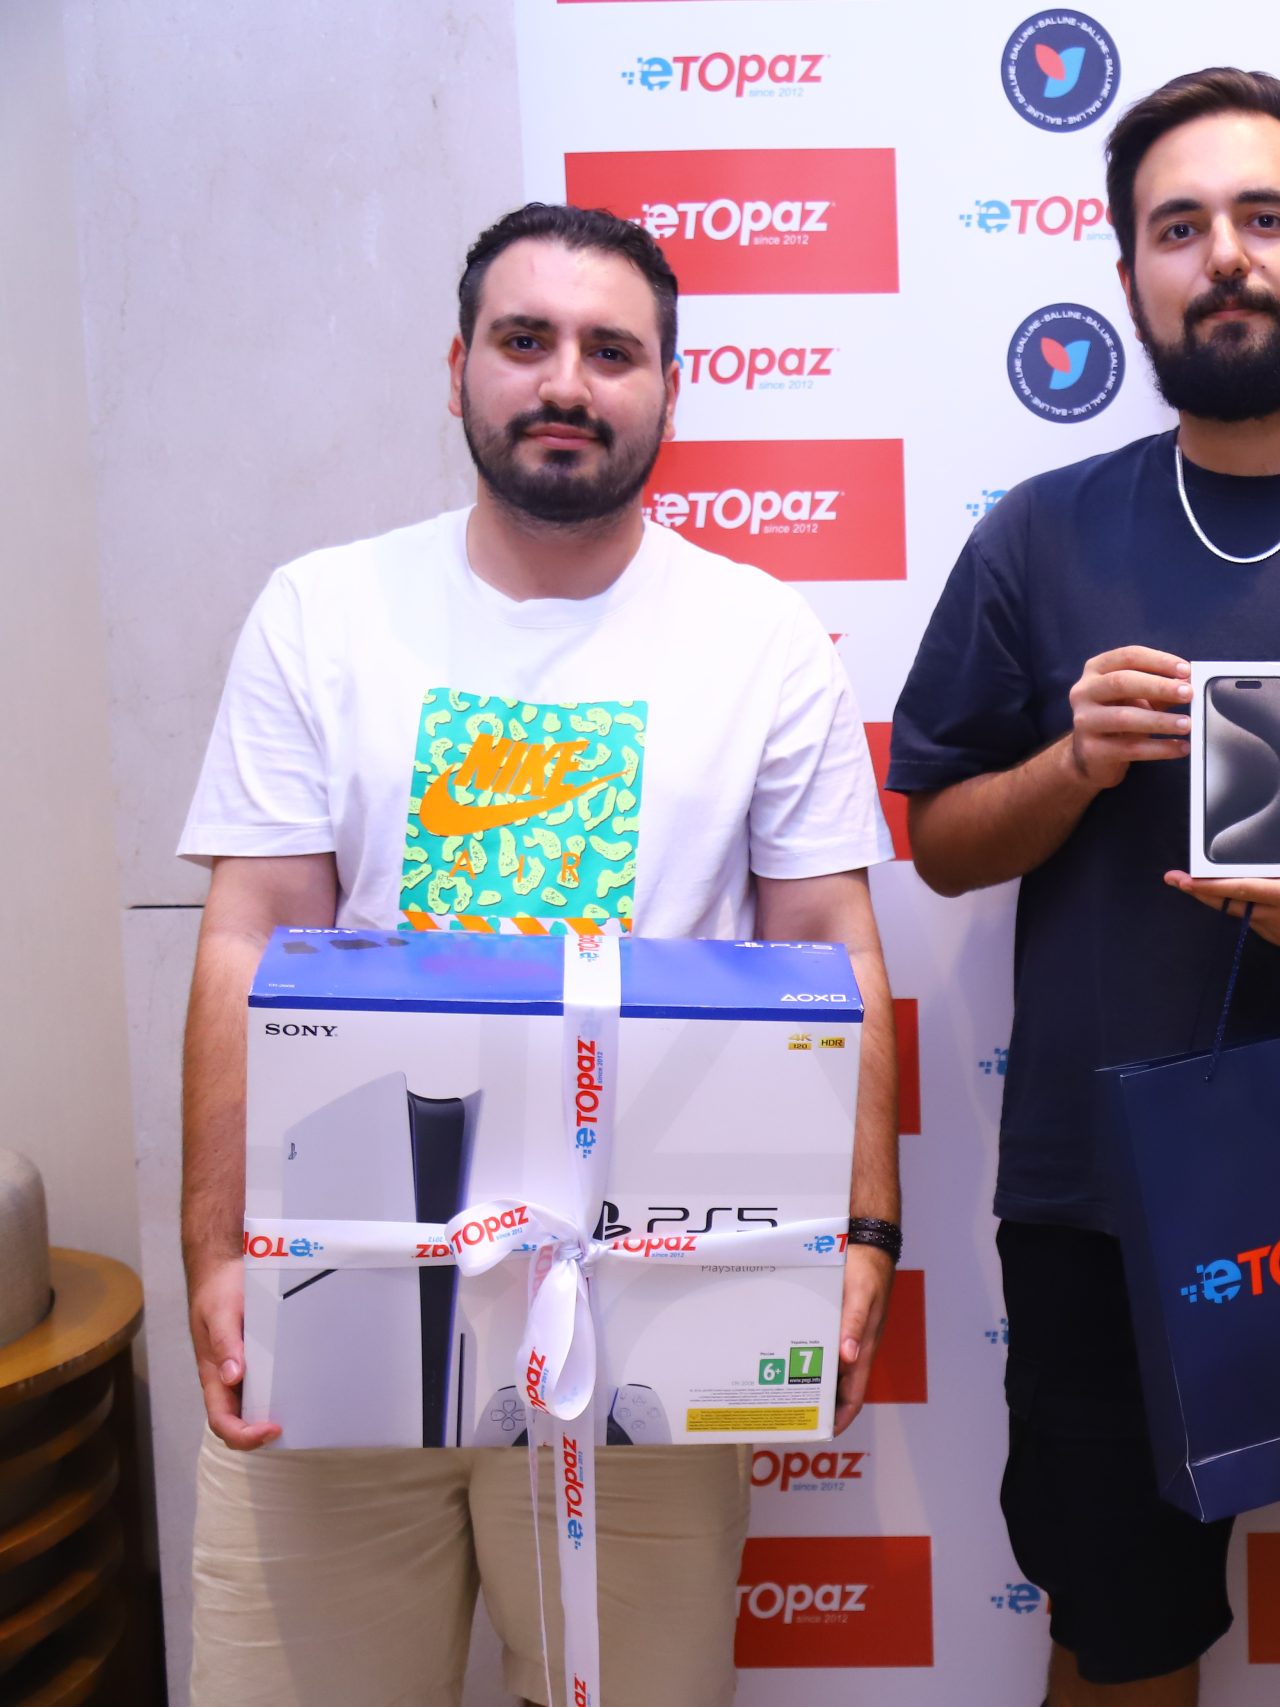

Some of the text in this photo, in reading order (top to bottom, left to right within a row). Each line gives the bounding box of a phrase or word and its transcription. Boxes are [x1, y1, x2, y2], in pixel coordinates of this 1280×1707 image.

[636, 52, 825, 97] eTOpaz
[748, 87, 804, 97] since 2012
[975, 196, 1114, 241] eTOp
[753, 234, 809, 245] since 2012
[675, 345, 834, 390] TOpaz
[788, 379, 814, 389] 2012
[653, 489, 839, 535] eTOpaz
[763, 523, 819, 534] since 2012
[452, 733, 590, 798] NIKE
[265, 1023, 337, 1037] SONY
[821, 1039, 843, 1047] HDR
[575, 1039, 603, 1149] eTOpaz
[451, 1205, 529, 1254] TOpaz
[646, 1207, 778, 1233] PS5
[763, 1363, 782, 1381] 6+
[799, 1350, 814, 1374] 7
[526, 1350, 549, 1414] paz
[820, 1482, 845, 1491] 2012
